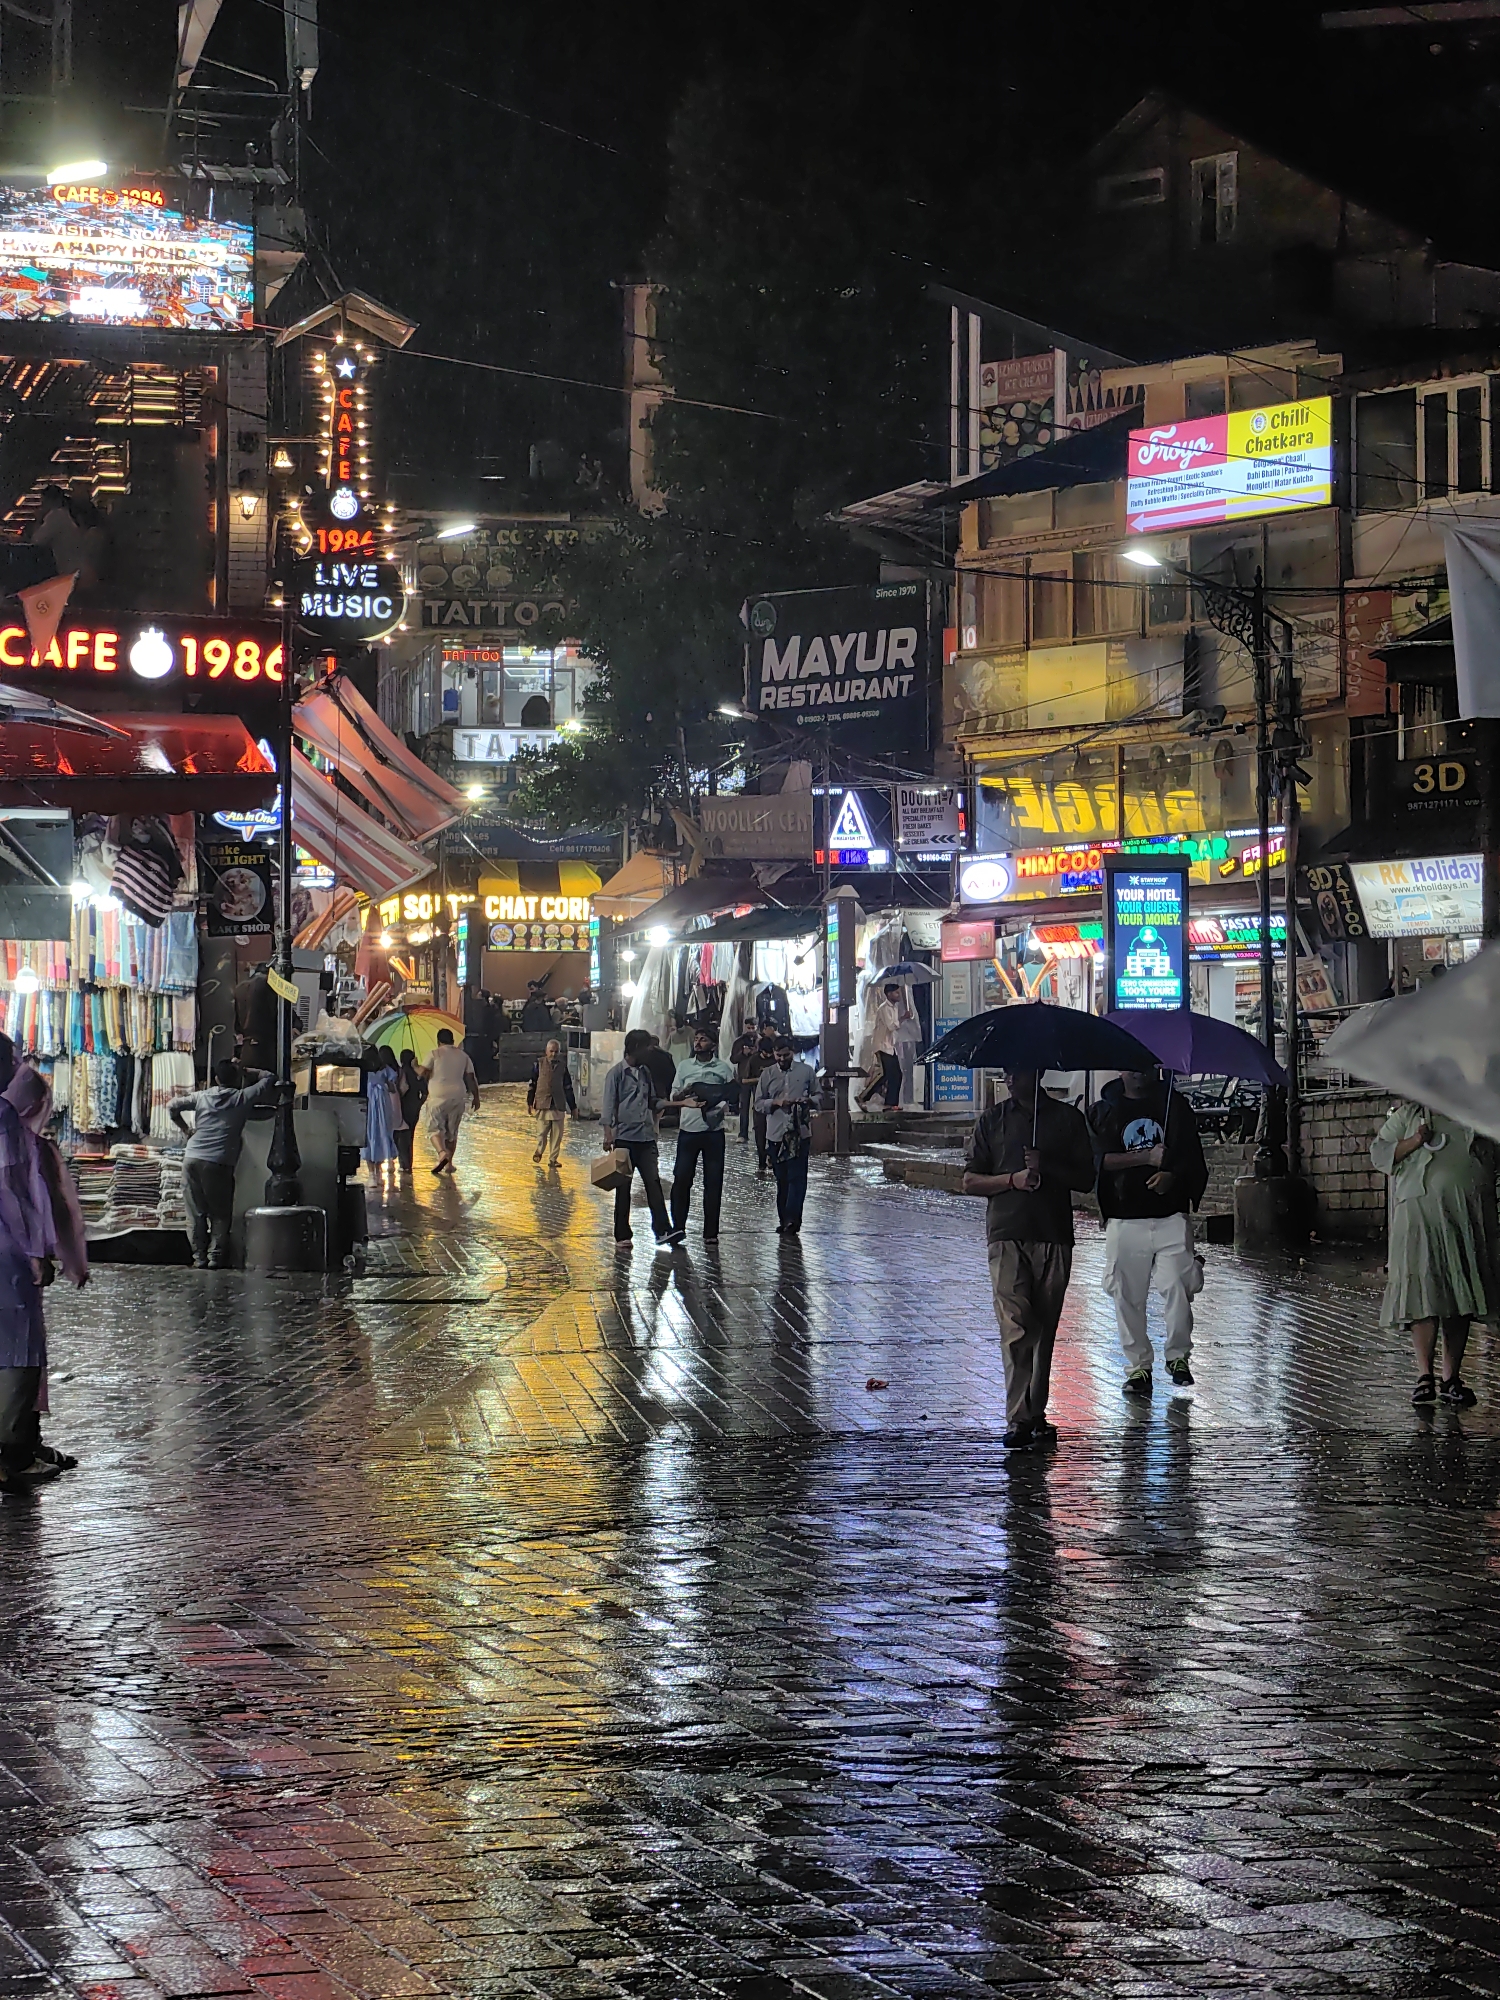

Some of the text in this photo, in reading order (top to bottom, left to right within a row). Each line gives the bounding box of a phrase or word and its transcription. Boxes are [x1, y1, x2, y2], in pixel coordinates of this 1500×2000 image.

[53, 185, 165, 207] CAFE 1986
[50, 223, 95, 237] VISIT
[129, 228, 169, 242] NOW
[53, 241, 66, 254] A
[69, 242, 127, 257] HAPPY
[1271, 407, 1310, 429] Chilli
[338, 389, 353, 480] CAFE
[1245, 431, 1314, 454] Chatkara
[1138, 426, 1214, 469] Froyo
[316, 529, 376, 556] 1986
[315, 563, 379, 588] LIVE
[875, 585, 916, 598] Since 1970
[301, 593, 393, 620] MUSIC
[0, 625, 284, 681] CAFE 1986
[441, 650, 500, 662] TATTOO
[761, 627, 918, 683] MAYUR
[759, 674, 914, 711] RESTAURANT
[1413, 762, 1466, 793] 3D
[255, 812, 277, 824] One
[702, 809, 812, 832] WOOLLEN CEN
[209, 845, 240, 856] Bake
[209, 854, 266, 866] DELIGHT
[1184, 837, 1229, 862] BAR
[1242, 836, 1284, 863] FRIT
[1307, 866, 1333, 891] 3D
[1378, 862, 1410, 886] RK
[1116, 888, 1181, 901] YOUR HOTEL.
[1389, 880, 1469, 895] www.rkholidays.in
[484, 895, 539, 920] CHAT
[1116, 901, 1182, 913] YOUR GUESTS.
[1329, 864, 1364, 936] TATTOO
[241, 923, 271, 933] SHOP
[1116, 913, 1181, 926] YOUR MONEY.
[1219, 915, 1286, 931] FAST FOD
[1406, 920, 1430, 928] TEMPO
[1227, 927, 1287, 942] PURE EG
[1371, 929, 1396, 938] SCAN
[940, 1075, 968, 1084] Booking
